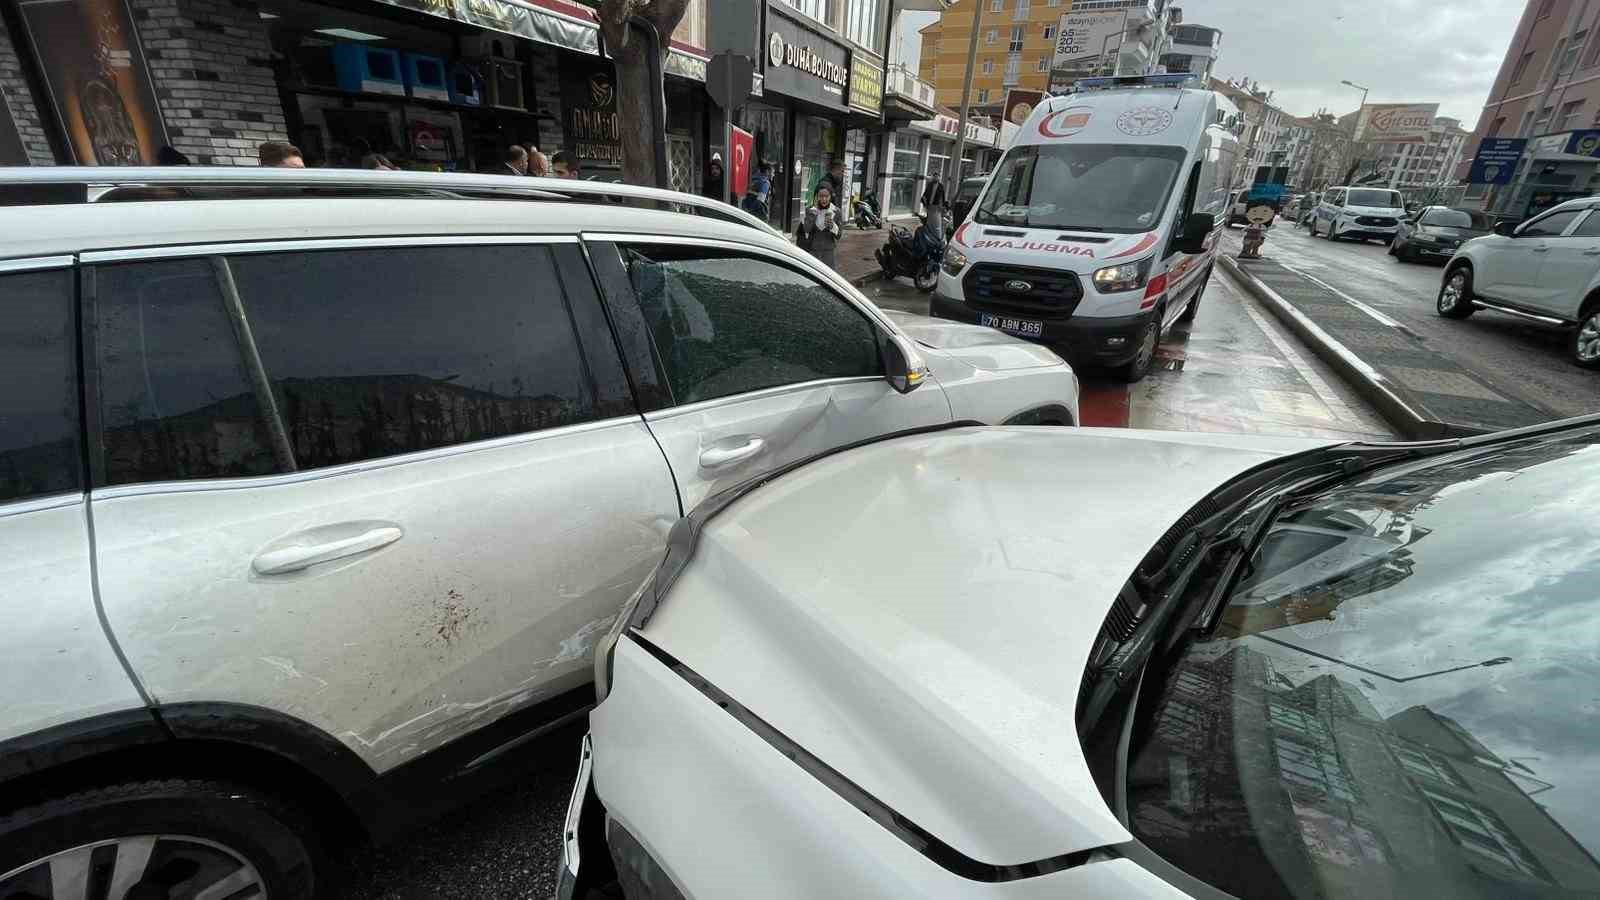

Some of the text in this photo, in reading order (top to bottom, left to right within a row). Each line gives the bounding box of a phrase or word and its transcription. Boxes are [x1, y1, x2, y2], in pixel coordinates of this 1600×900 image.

[1061, 28, 1075, 37] 65
[1060, 37, 1074, 46] 20
[1057, 46, 1080, 54] 300
[811, 54, 848, 86] BOUTIQUE
[987, 317, 1041, 333] 70 ABN 365
